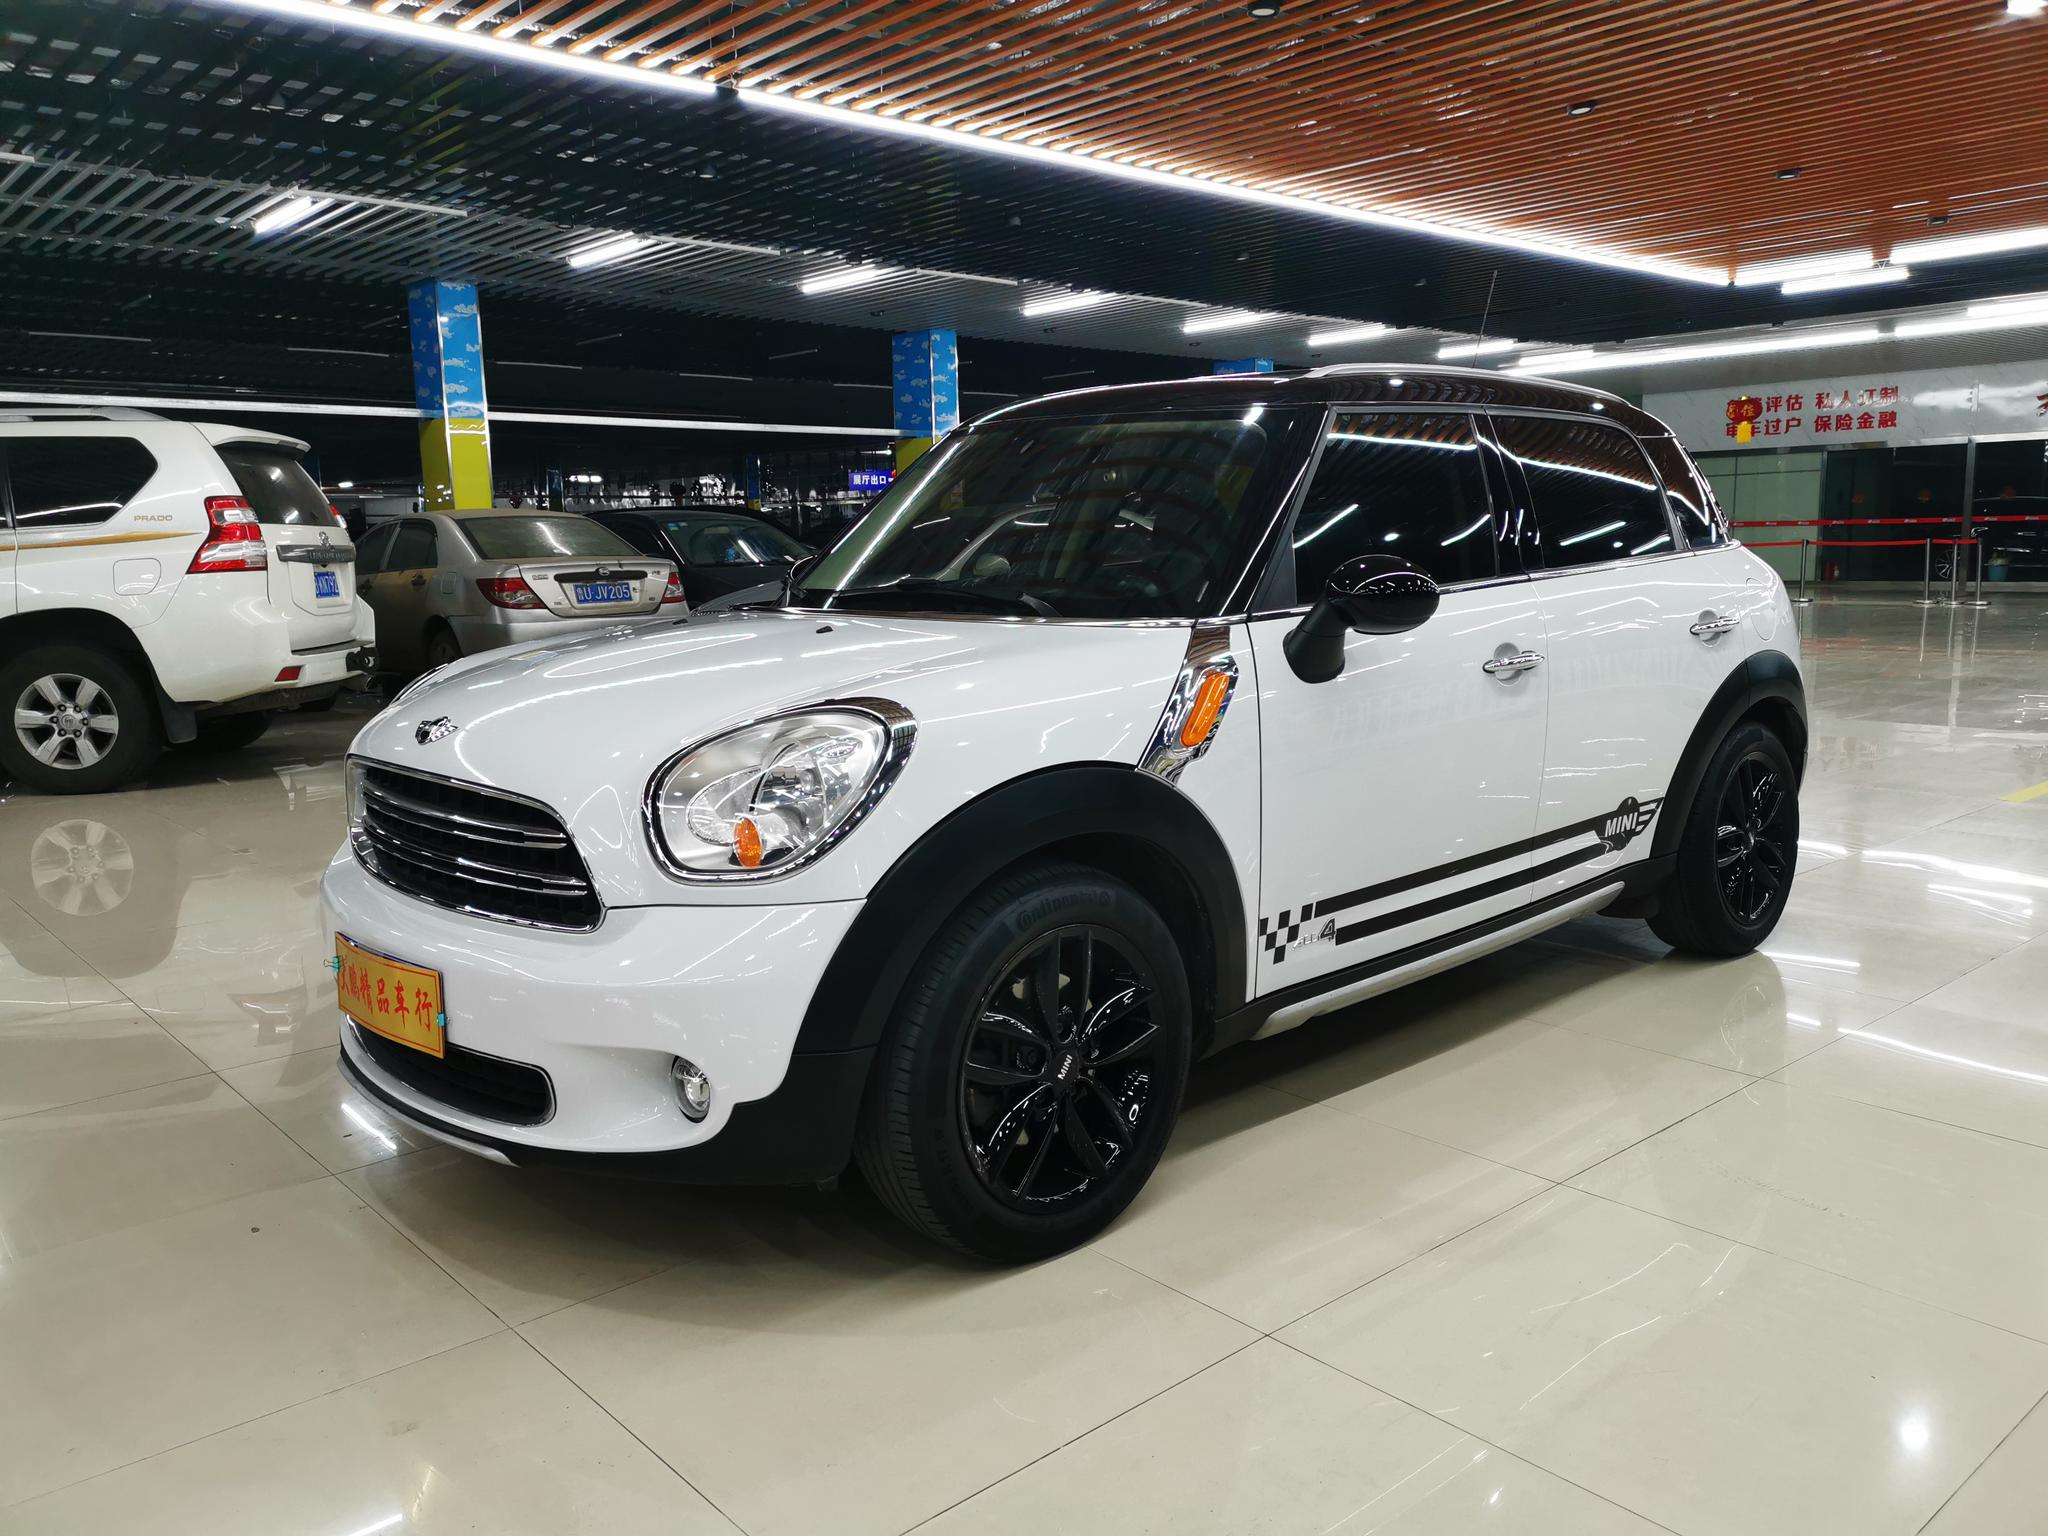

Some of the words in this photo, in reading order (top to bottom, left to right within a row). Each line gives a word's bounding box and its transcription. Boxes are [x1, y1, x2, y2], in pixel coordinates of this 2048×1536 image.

[1815, 386, 1899, 410] 私人订制
[1814, 410, 1898, 433] 保险金融
[853, 474, 886, 485] 展厅出口
[1605, 812, 1638, 837] MINI
[1057, 1054, 1073, 1080] MINI
